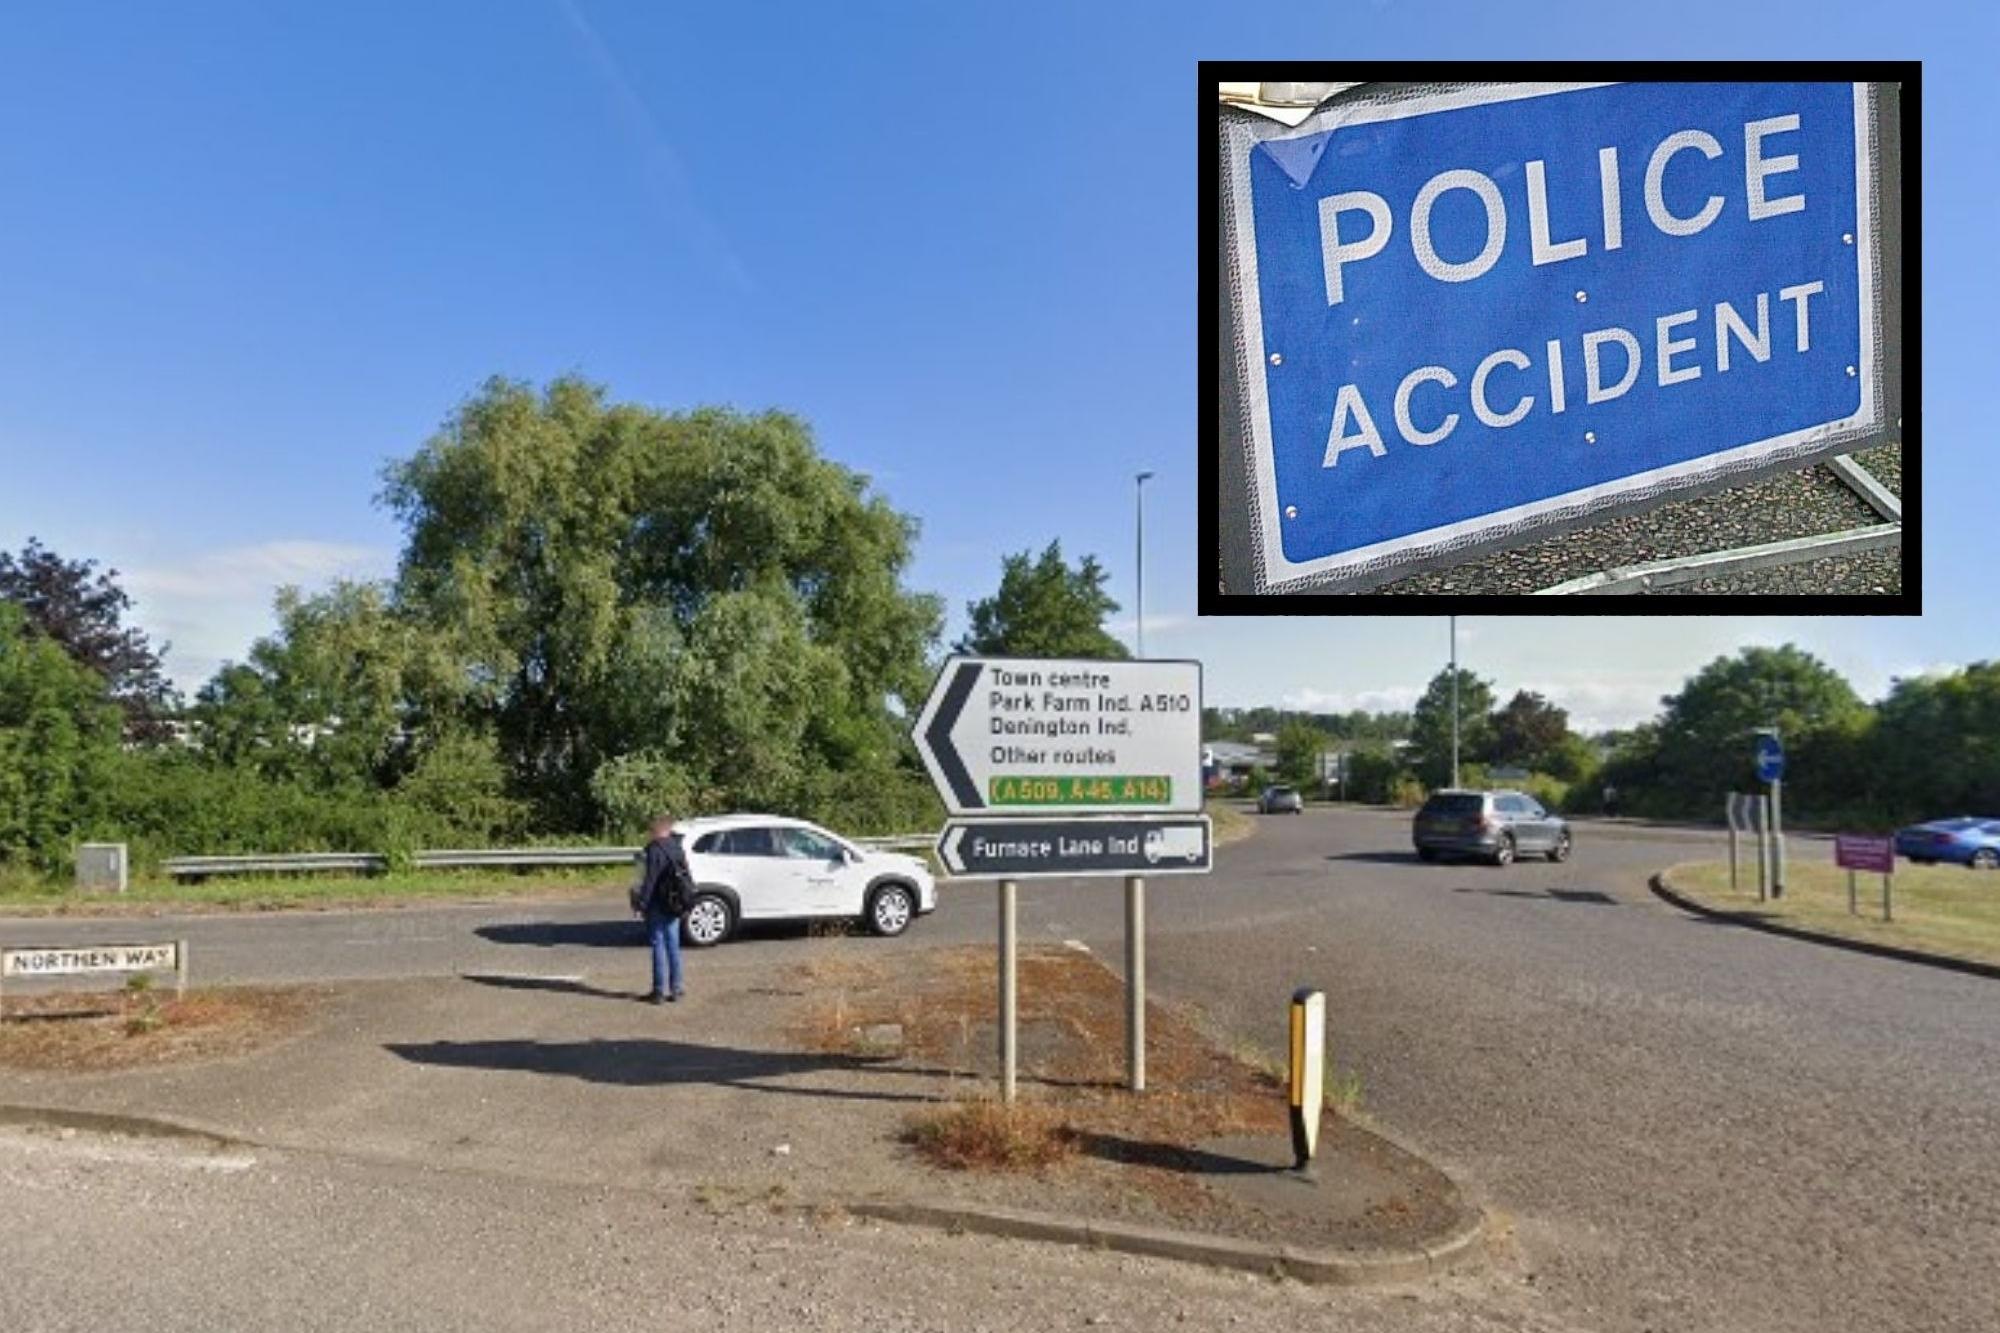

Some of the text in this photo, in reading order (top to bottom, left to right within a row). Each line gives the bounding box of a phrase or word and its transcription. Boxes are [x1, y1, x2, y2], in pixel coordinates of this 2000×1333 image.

[1317, 113, 1806, 306] POLICE
[1322, 280, 1825, 468] ACCIDENT
[991, 668, 1110, 688] Town centre
[990, 691, 1035, 712] Park
[1043, 692, 1090, 712] Farm
[1140, 694, 1191, 712] A510
[991, 717, 1090, 738] Denington
[991, 746, 1116, 764] Other routes
[972, 834, 1139, 859] Furnace Lane Ind
[13, 949, 169, 971] NORTHEN WAY
